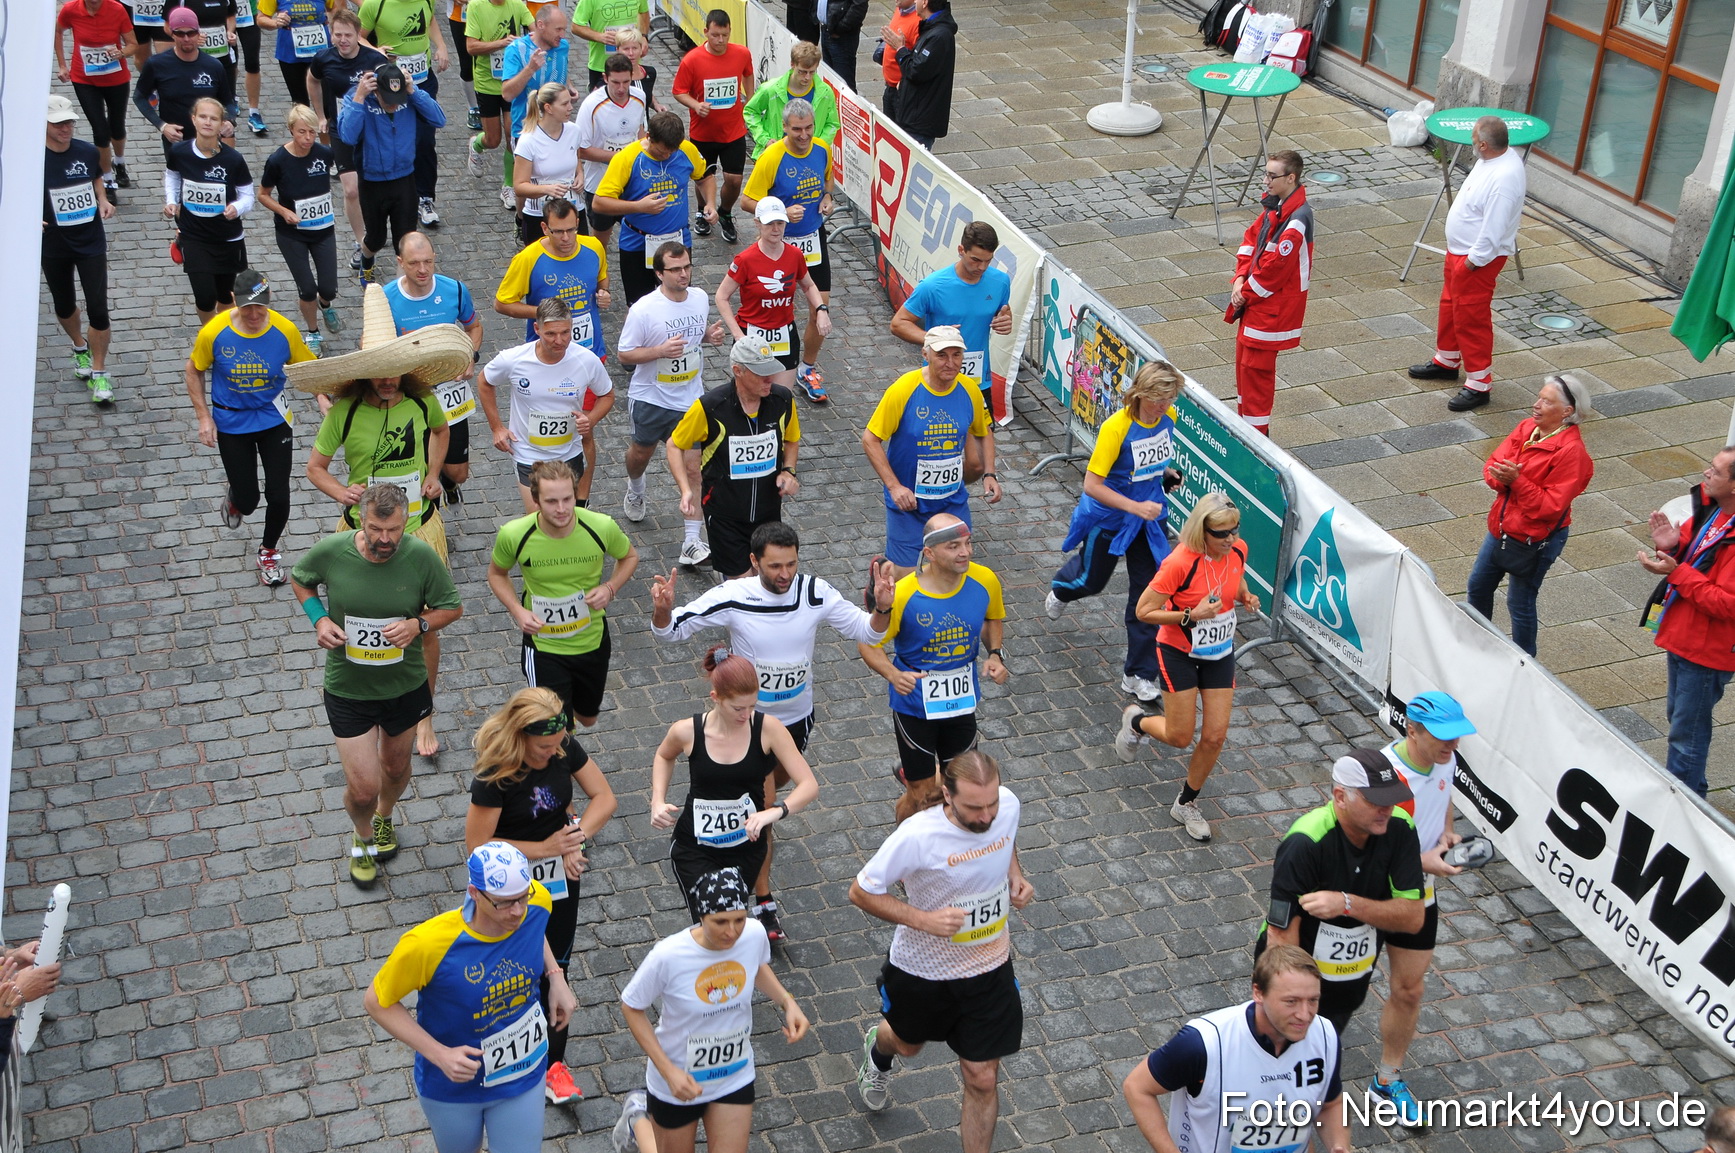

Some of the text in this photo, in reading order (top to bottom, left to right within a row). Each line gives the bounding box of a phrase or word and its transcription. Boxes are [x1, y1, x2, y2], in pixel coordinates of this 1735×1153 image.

[137, 4, 164, 16] 2422
[201, 34, 225, 48] 063
[297, 33, 325, 47] 2723
[86, 52, 114, 65] 273
[708, 85, 736, 98] 2178
[57, 194, 92, 213] 2889
[187, 190, 222, 203] 2924
[68, 212, 89, 220] Richard
[301, 202, 330, 220] 2840
[761, 297, 792, 309] RWE
[665, 315, 704, 331] NOVINA
[671, 357, 688, 374] 31
[443, 386, 466, 409] 207
[451, 404, 469, 418] Michael
[539, 421, 568, 436] 623
[371, 435, 392, 461] GOSSEN
[735, 443, 774, 463] 2522
[1138, 441, 1170, 467] 2265
[374, 459, 415, 470] METRAWATT
[745, 463, 767, 473] Hubert
[922, 467, 959, 485] 2798
[532, 554, 599, 568] GOSSEN METRAWATT
[543, 604, 579, 624] 214
[346, 619, 367, 629] PARTL
[550, 623, 578, 634] Bastian
[1197, 622, 1234, 646] 2902
[1317, 625, 1342, 651] Service
[1341, 643, 1364, 668] GmbH
[364, 651, 386, 660] Peter
[776, 664, 804, 672] Neumarkt
[760, 669, 807, 690] 2762
[928, 675, 970, 698] 2106
[774, 692, 792, 701] Rico
[945, 702, 959, 710] Can
[1454, 764, 1503, 822] verbinden
[715, 803, 745, 811] Neumarkt
[701, 809, 750, 834] 2461
[712, 831, 744, 844] Daniela
[947, 837, 1005, 868] Continental
[968, 899, 1002, 927] 154
[1534, 842, 1683, 992] stadtwerke
[970, 925, 997, 941] Günter
[1320, 928, 1344, 940] PARTL
[1329, 937, 1370, 961] 296
[1335, 964, 1359, 974] Horst
[483, 1035, 507, 1052] PARTL
[507, 1016, 534, 1040] Neumarkt
[491, 1022, 544, 1070] 2174
[693, 1038, 745, 1068] 2091
[706, 1067, 729, 1080] Julia
[1293, 1057, 1325, 1088] 13
[1239, 1125, 1301, 1147] 2571
